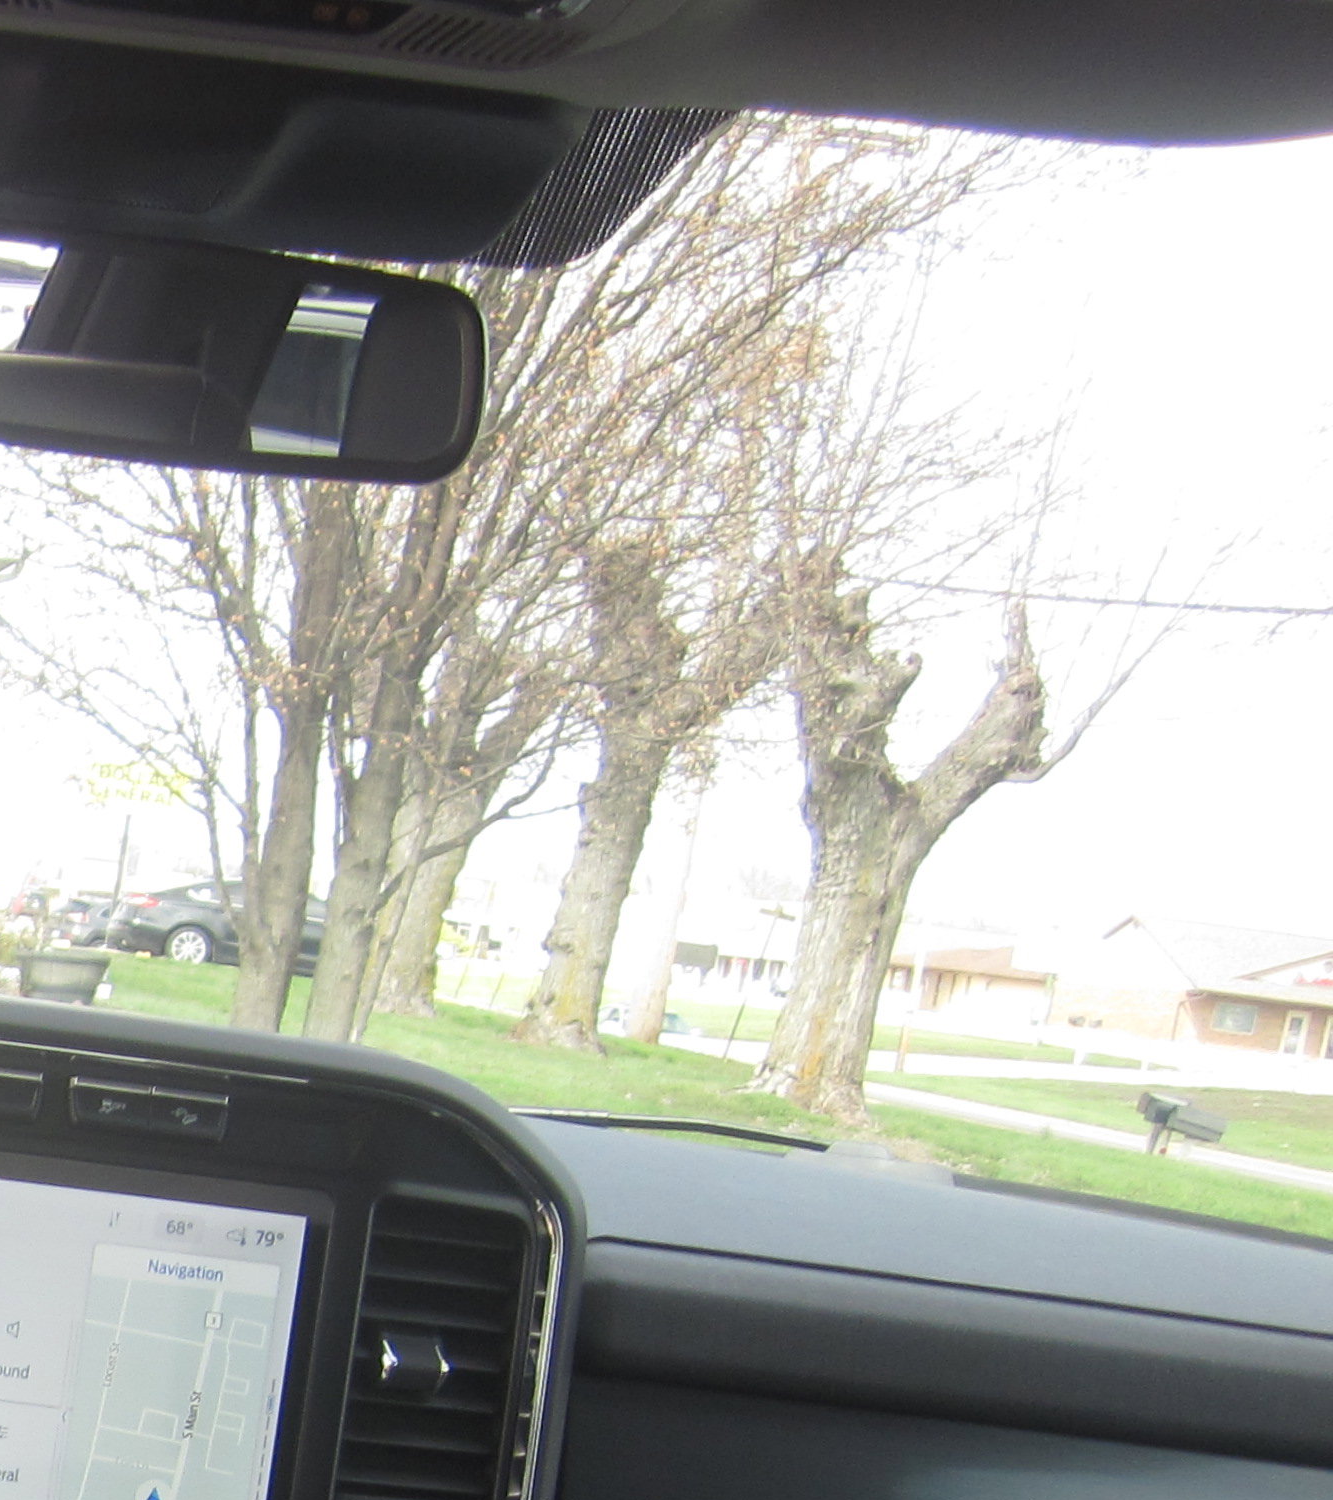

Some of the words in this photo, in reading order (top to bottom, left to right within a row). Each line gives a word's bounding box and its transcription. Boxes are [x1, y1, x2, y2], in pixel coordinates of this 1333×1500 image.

[166, 1219, 194, 1236] 68°
[254, 1229, 285, 1248] 79°
[147, 1258, 224, 1283] Navigation
[190, 1390, 203, 1404] St
[183, 1405, 200, 1432] Main
